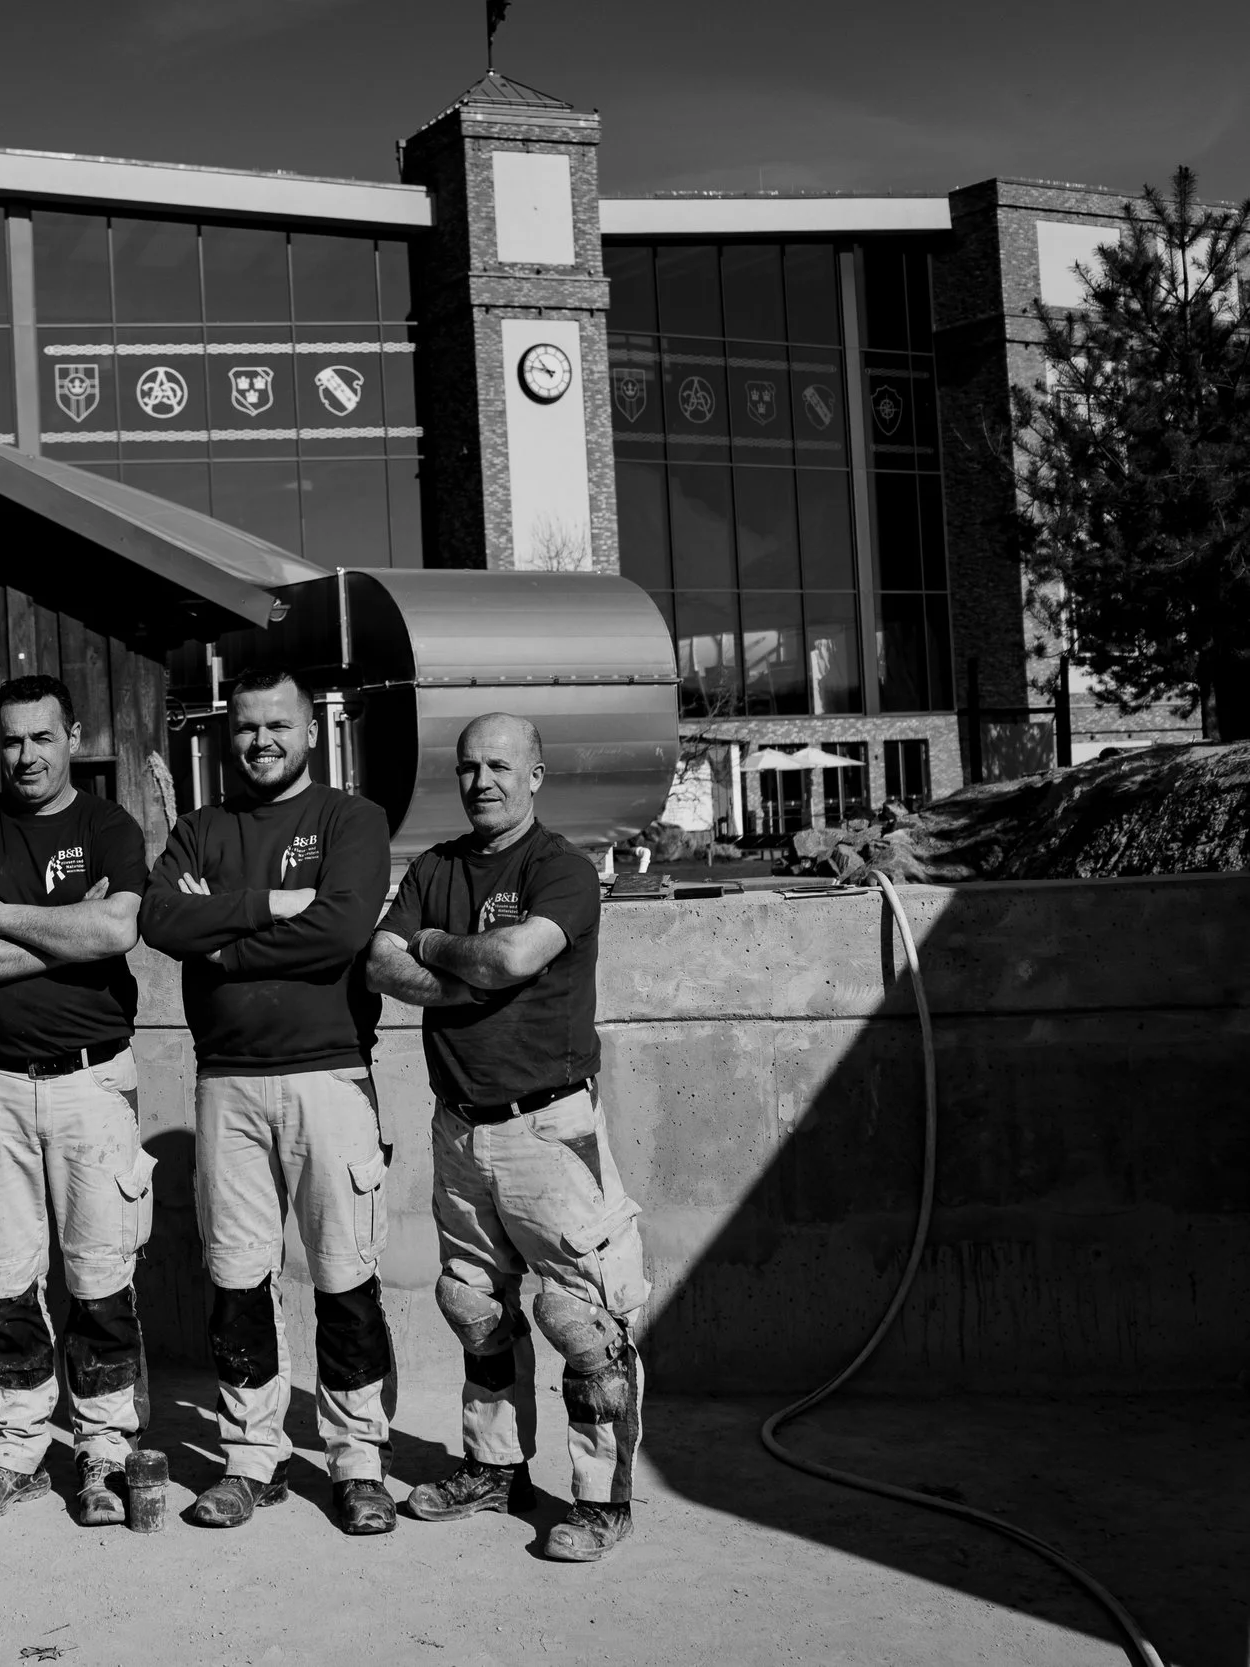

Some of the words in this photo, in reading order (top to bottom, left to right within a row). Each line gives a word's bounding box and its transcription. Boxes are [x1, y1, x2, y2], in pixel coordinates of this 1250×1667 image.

[293, 834, 317, 847] B&B
[58, 846, 83, 860] B&B
[494, 892, 519, 903] B&B
